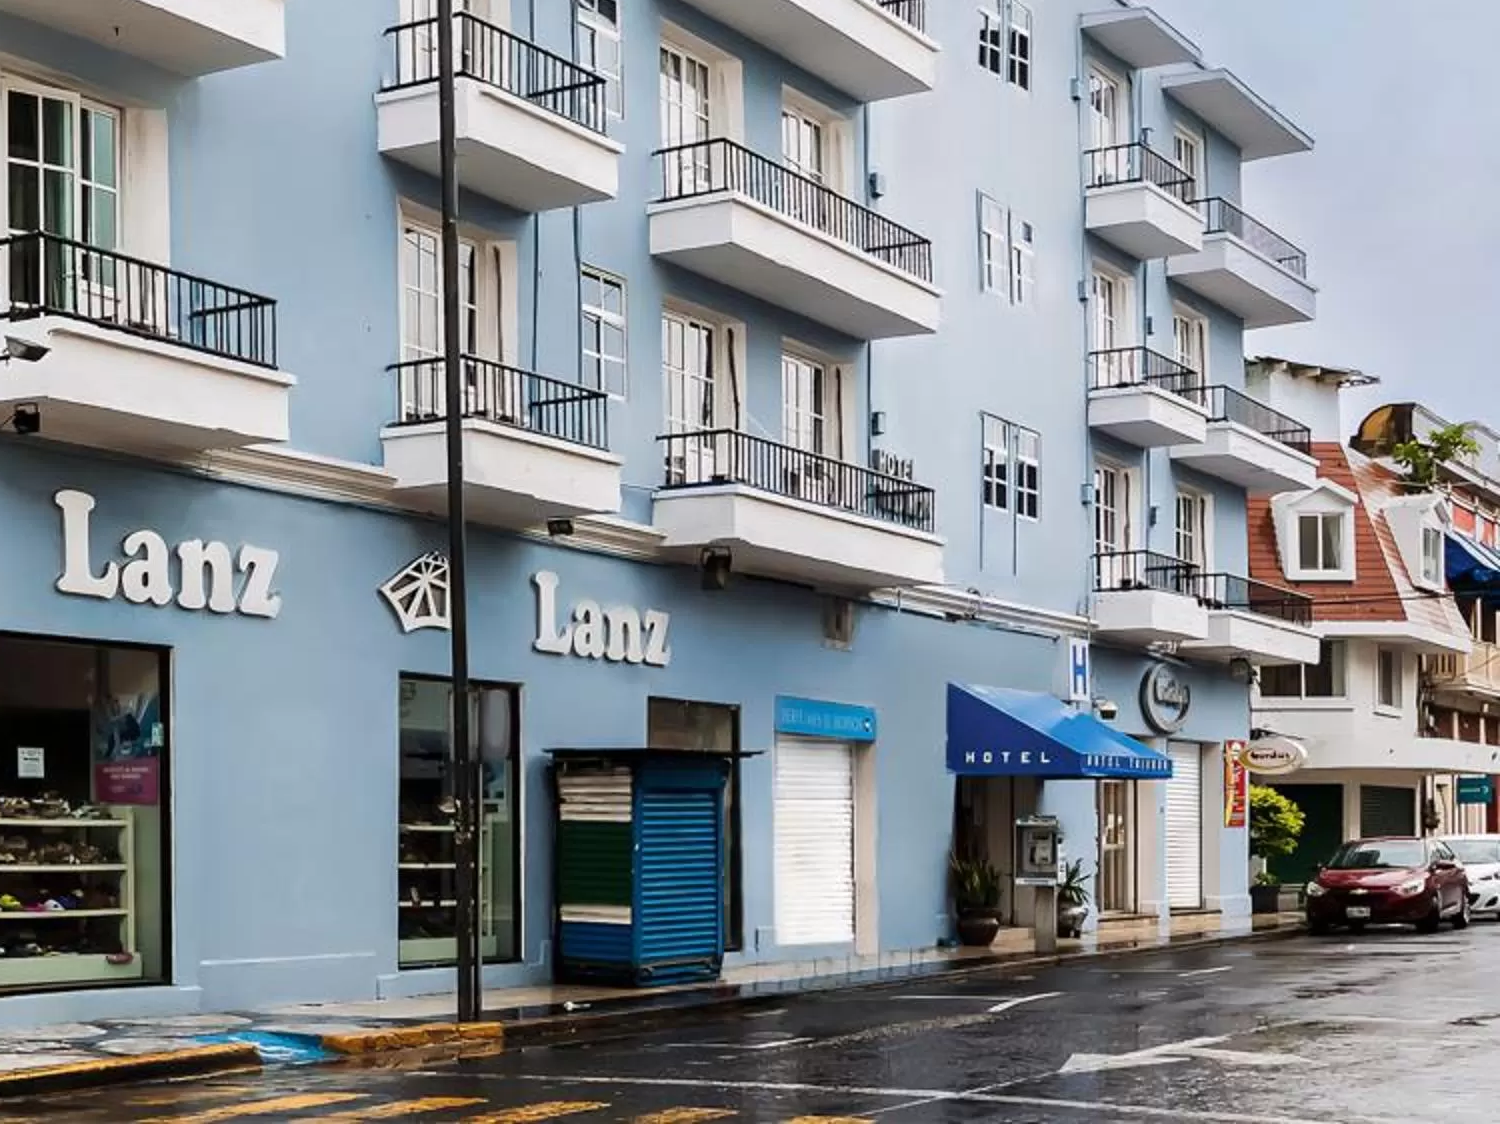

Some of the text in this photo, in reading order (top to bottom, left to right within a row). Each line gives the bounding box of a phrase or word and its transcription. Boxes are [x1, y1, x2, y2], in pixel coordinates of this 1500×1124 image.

[53, 488, 283, 619] Lanz
[532, 569, 672, 667] Lanz
[1071, 644, 1088, 695] H
[964, 751, 1051, 764] HOTEL
